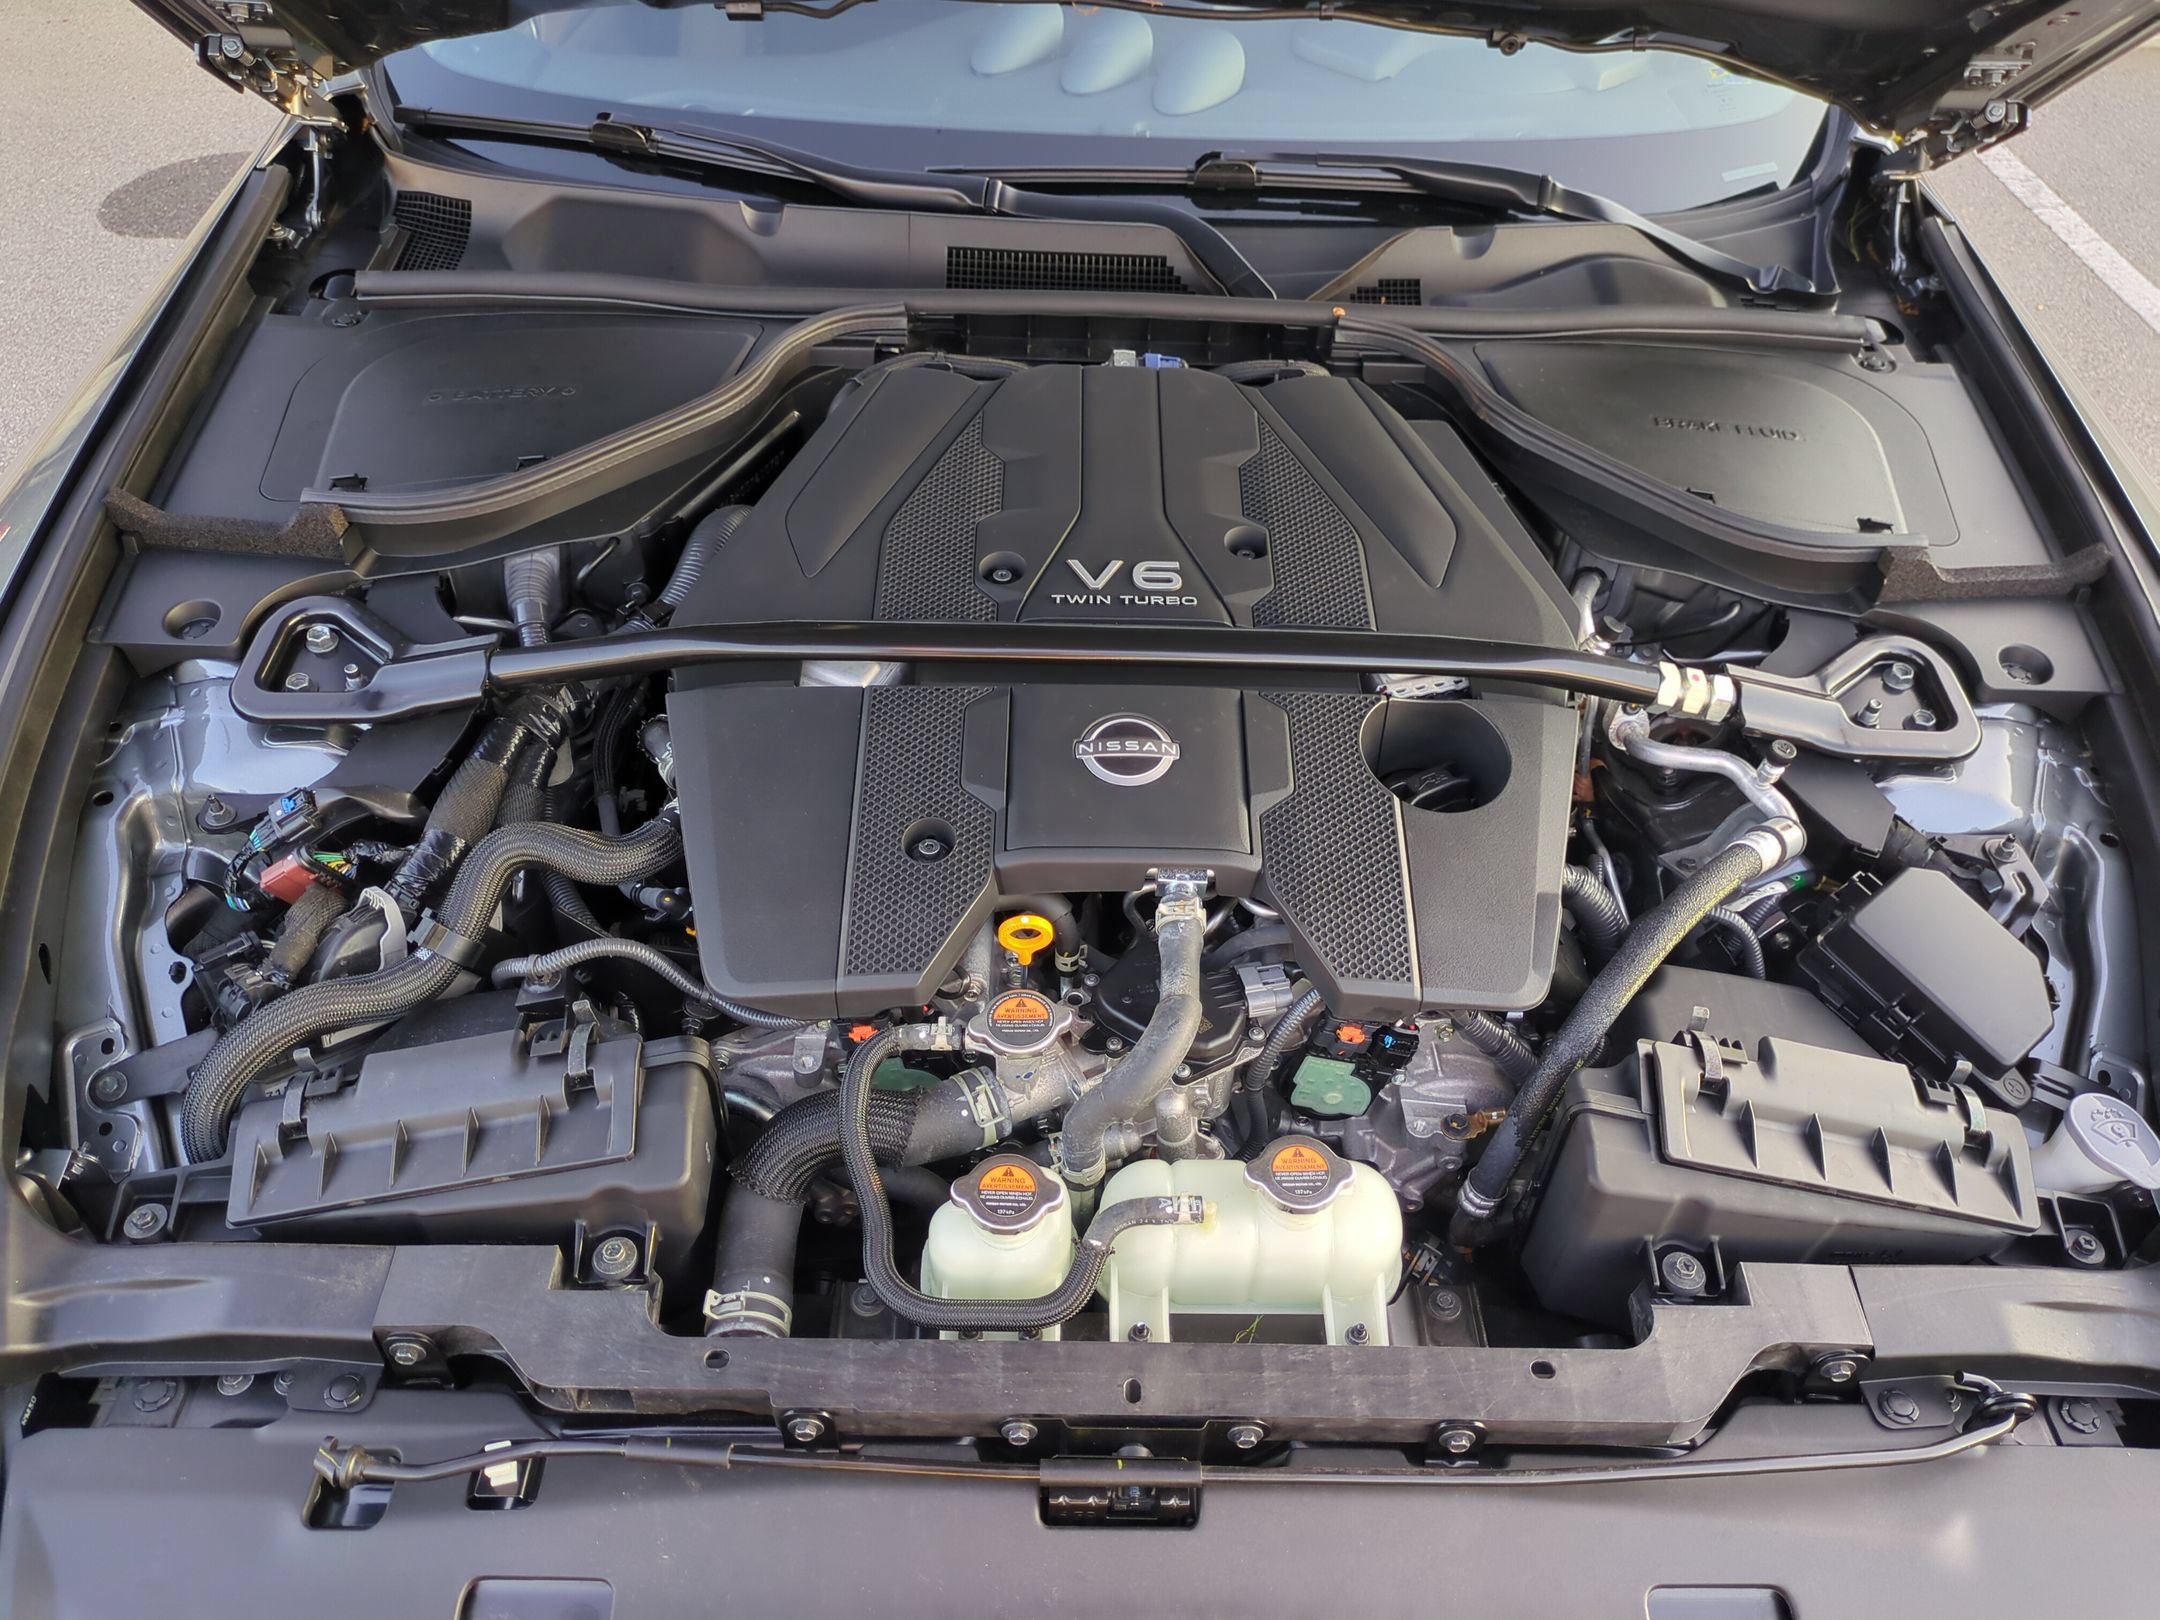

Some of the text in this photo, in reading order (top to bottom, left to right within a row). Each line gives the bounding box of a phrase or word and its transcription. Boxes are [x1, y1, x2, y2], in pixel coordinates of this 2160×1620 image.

[1065, 558, 1183, 592] V6
[1050, 594, 1199, 606] TWIN TURBO
[1078, 740, 1177, 755] NISSAN
